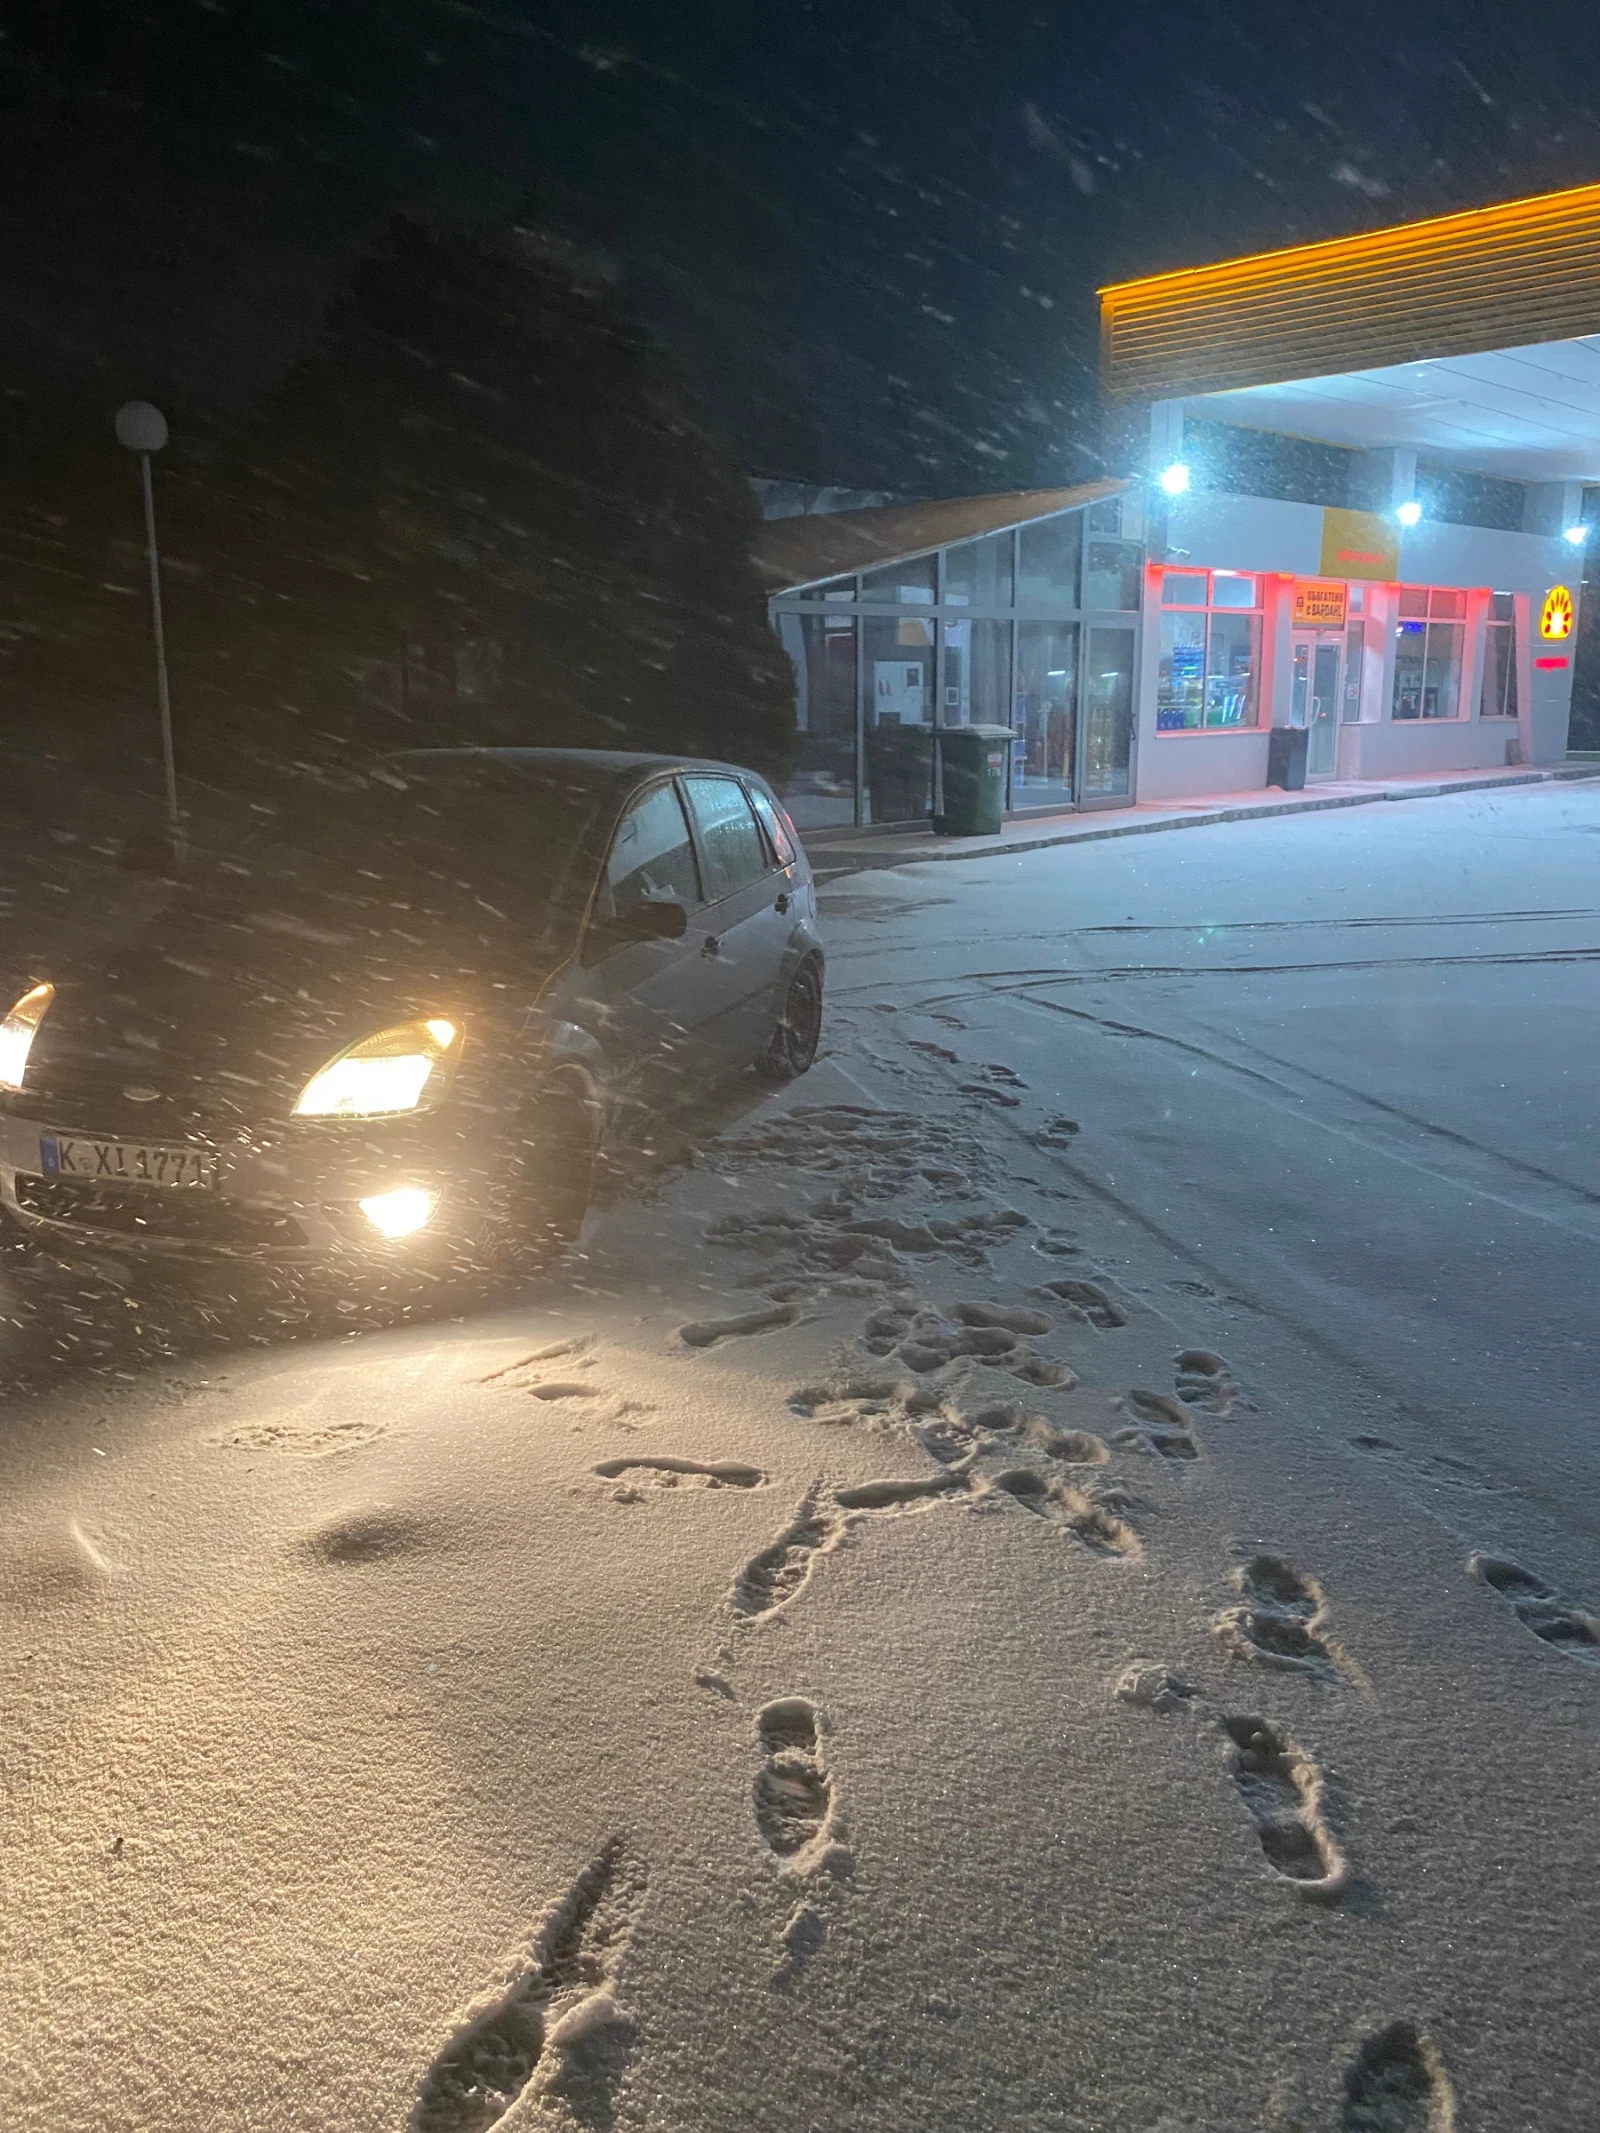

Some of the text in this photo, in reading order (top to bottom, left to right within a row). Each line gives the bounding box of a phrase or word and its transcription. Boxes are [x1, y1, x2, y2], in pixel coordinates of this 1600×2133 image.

[1307, 591, 1343, 602] ОБОГАТЕНО
[1312, 604, 1342, 616] BARDAHL
[59, 1142, 206, 1186] K XI 1771
